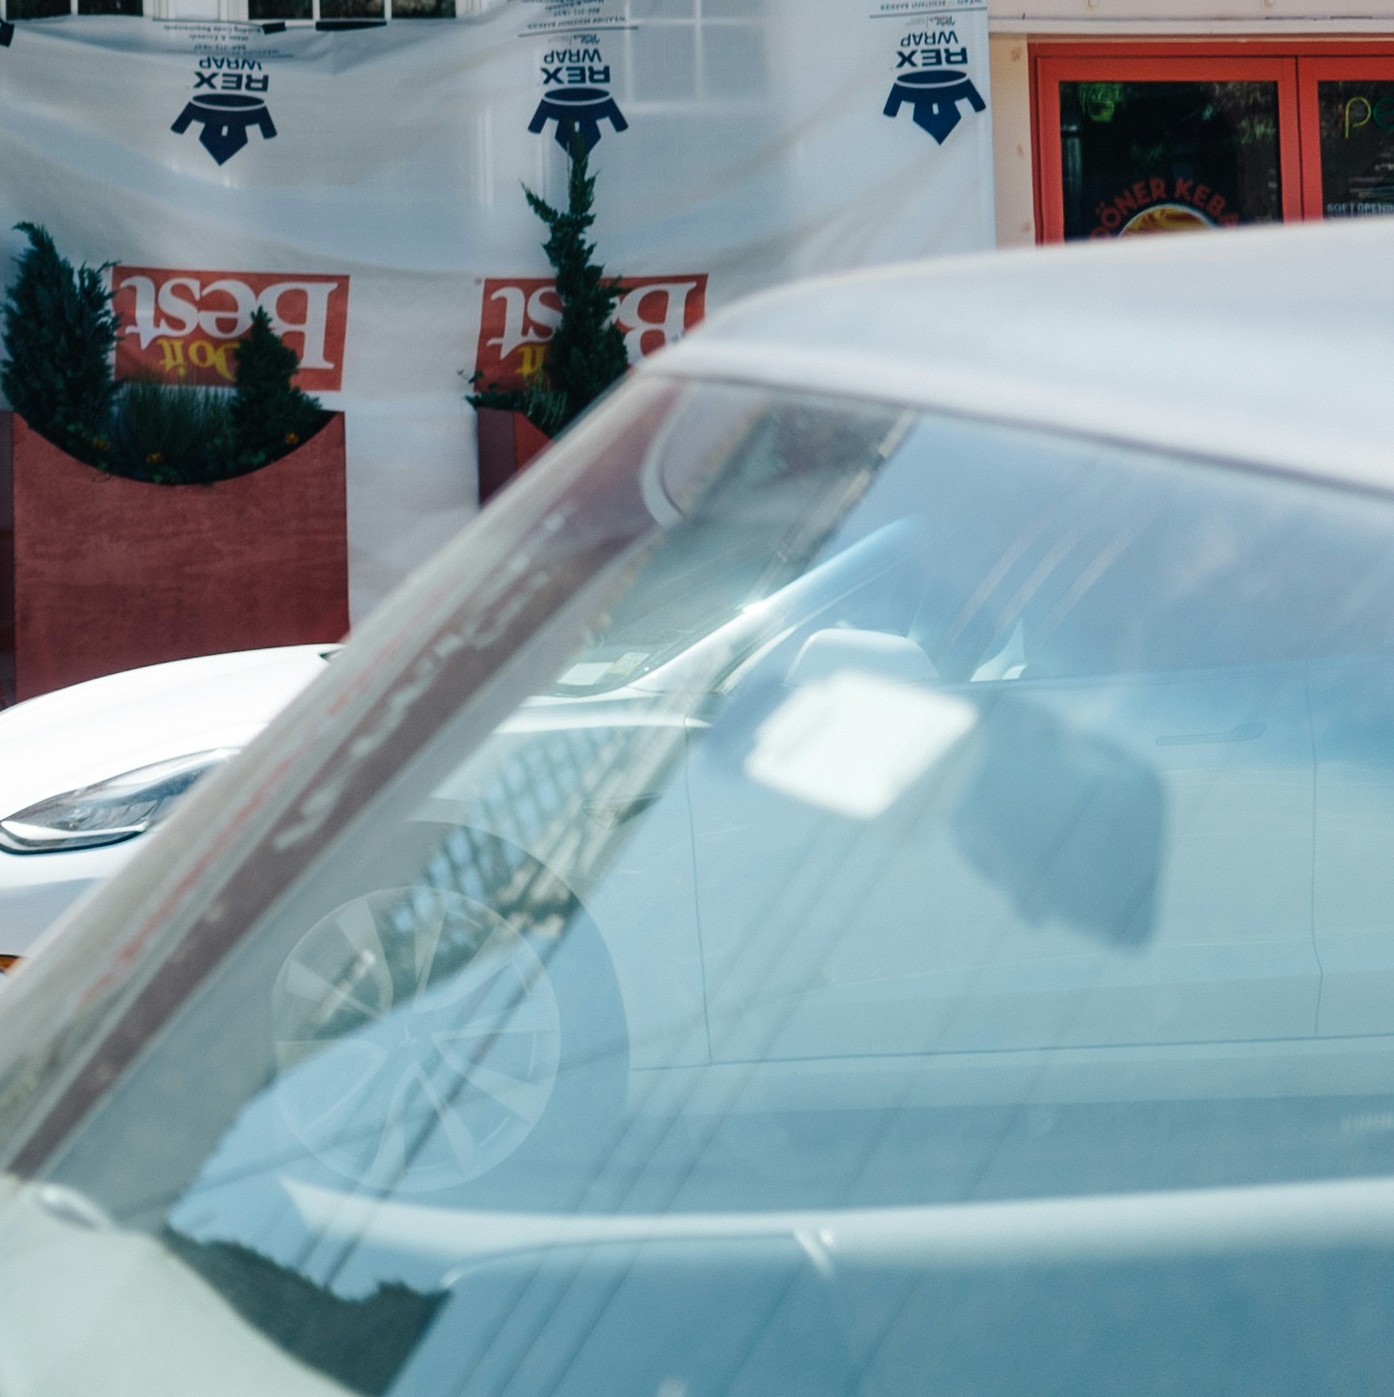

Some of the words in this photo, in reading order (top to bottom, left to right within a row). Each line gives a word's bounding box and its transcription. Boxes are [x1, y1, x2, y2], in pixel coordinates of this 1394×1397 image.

[900, 31, 958, 46] WRAP
[199, 56, 262, 71] WRAP
[544, 49, 601, 64] WRAP
[896, 48, 968, 68] REX
[193, 72, 269, 92] REX
[541, 66, 610, 84] REX
[119, 275, 338, 369] Best
[486, 282, 697, 366] Bst
